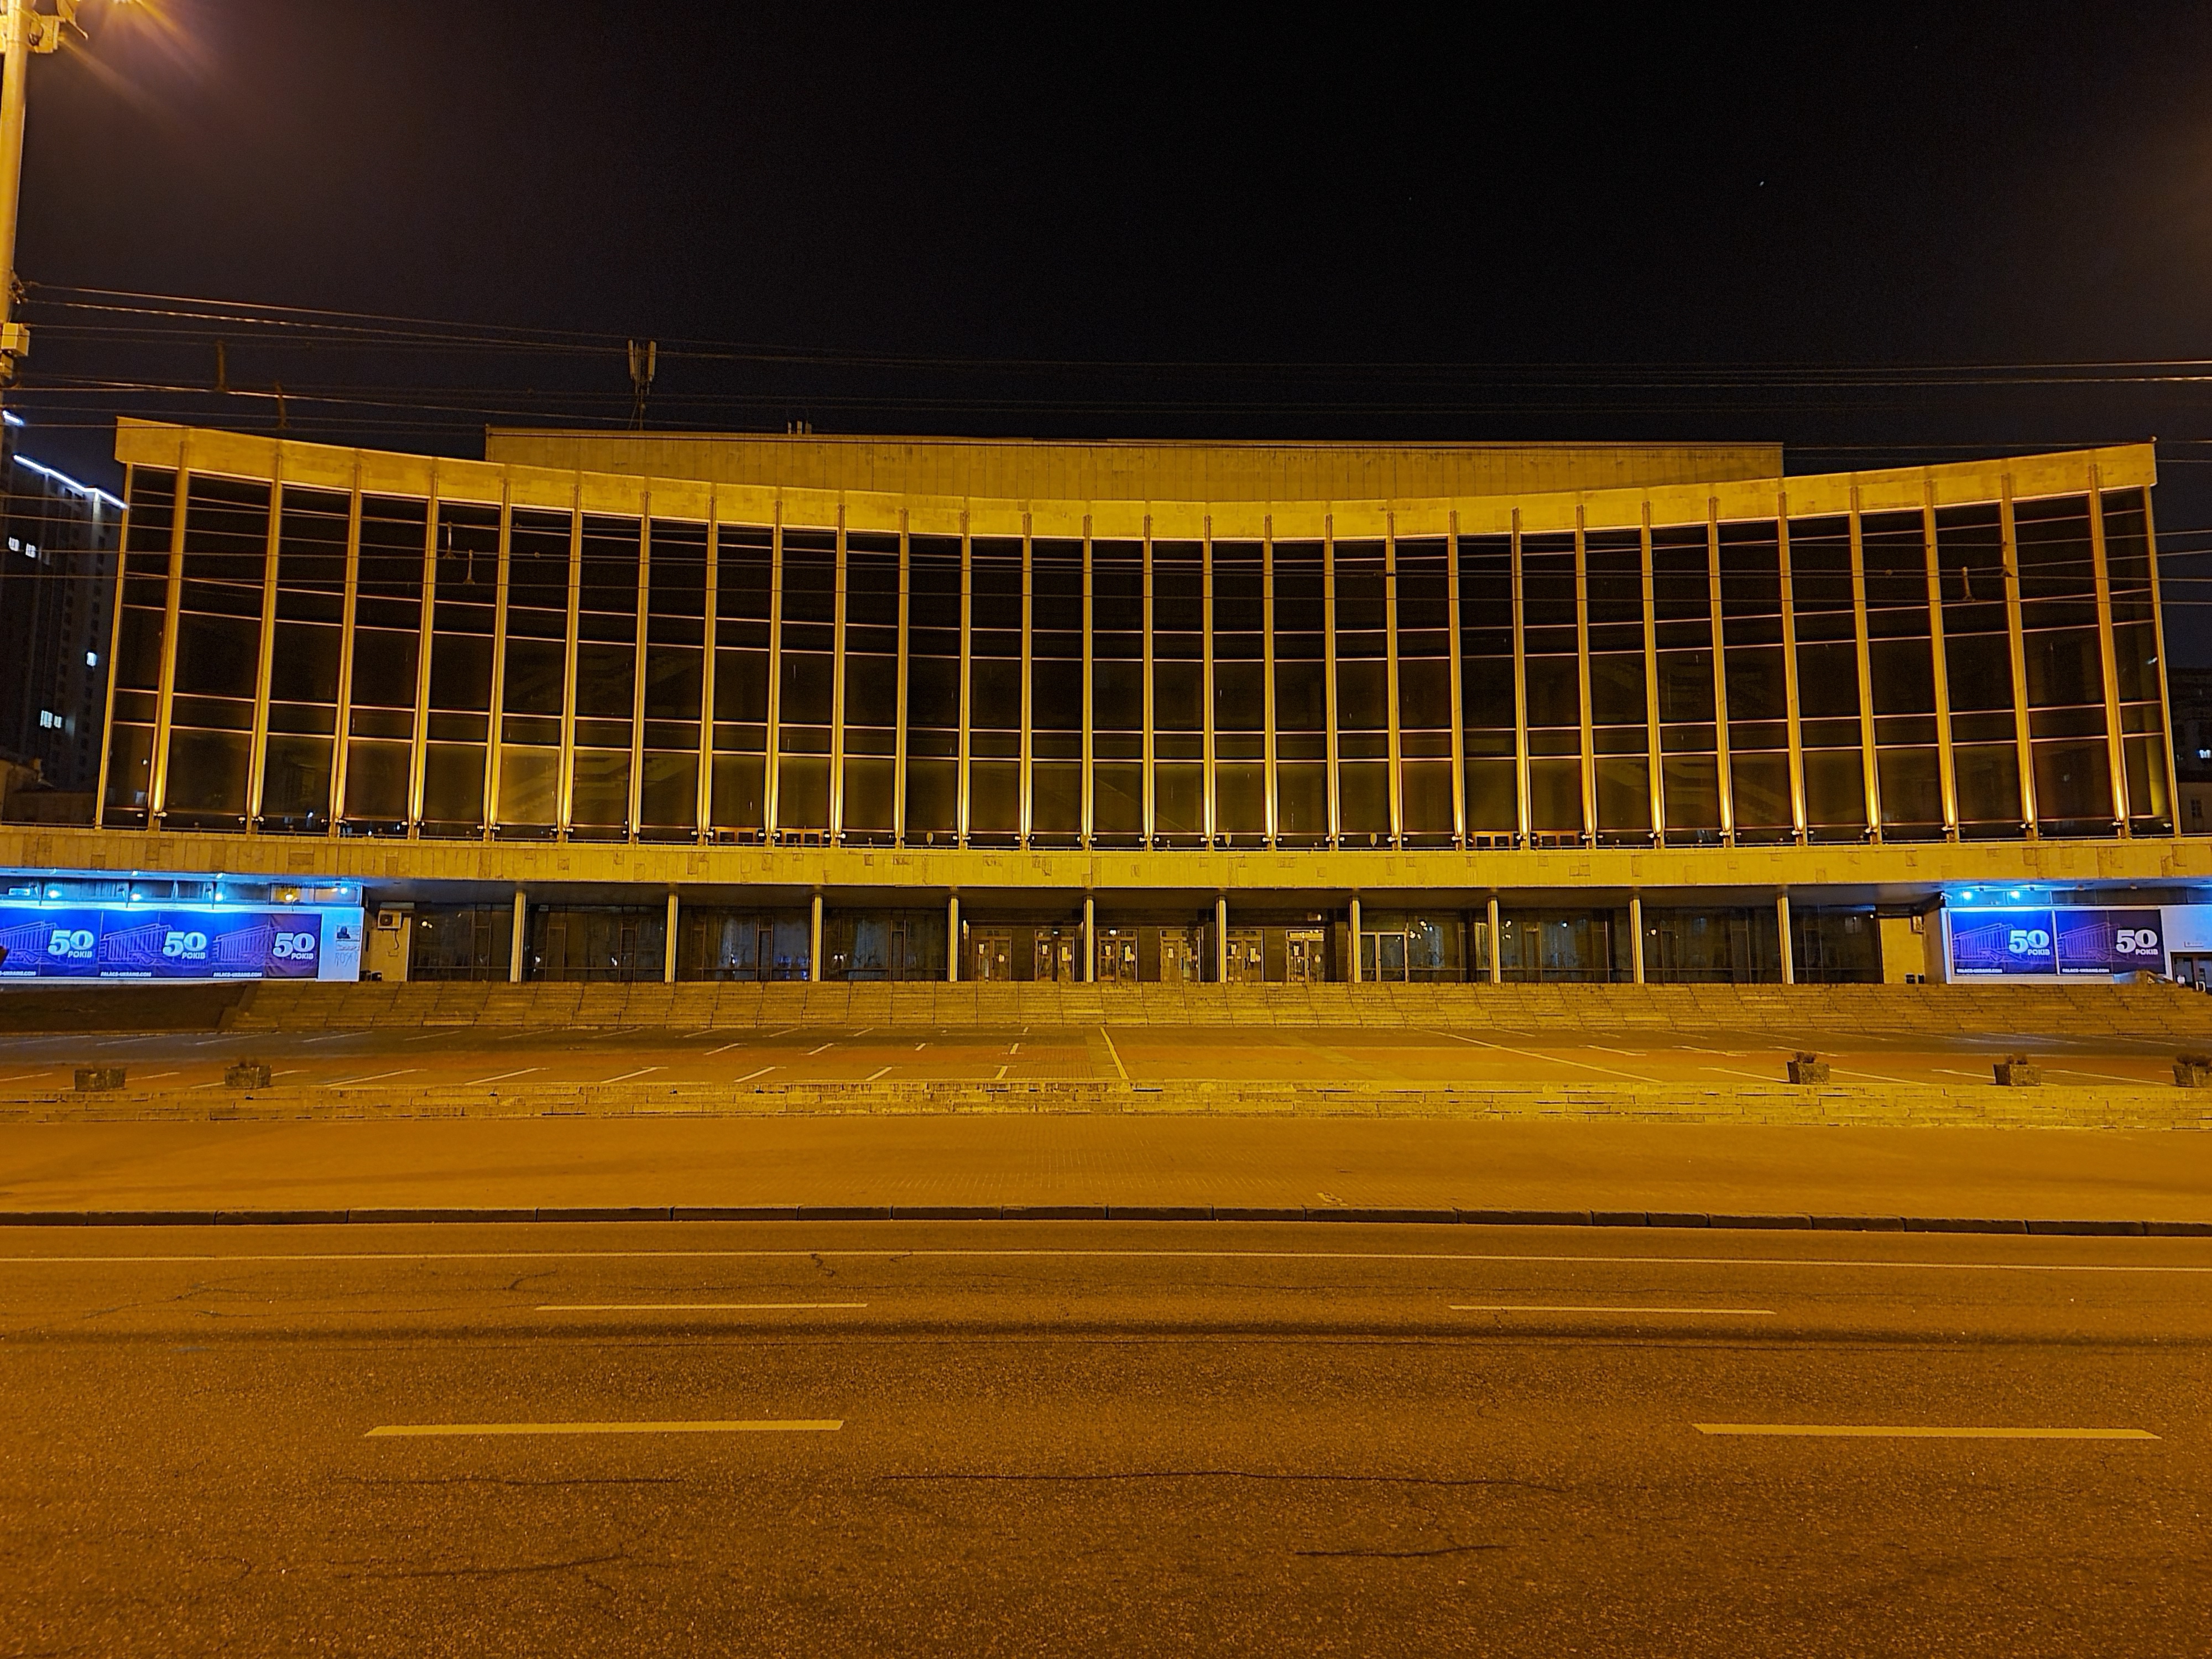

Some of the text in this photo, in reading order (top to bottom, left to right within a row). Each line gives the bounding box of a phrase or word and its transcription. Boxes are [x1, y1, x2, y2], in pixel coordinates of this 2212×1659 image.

[48, 930, 94, 955] 50
[163, 932, 206, 956] 50
[273, 932, 315, 957] 50
[2008, 930, 2049, 953] 50
[2116, 929, 2157, 953] 50
